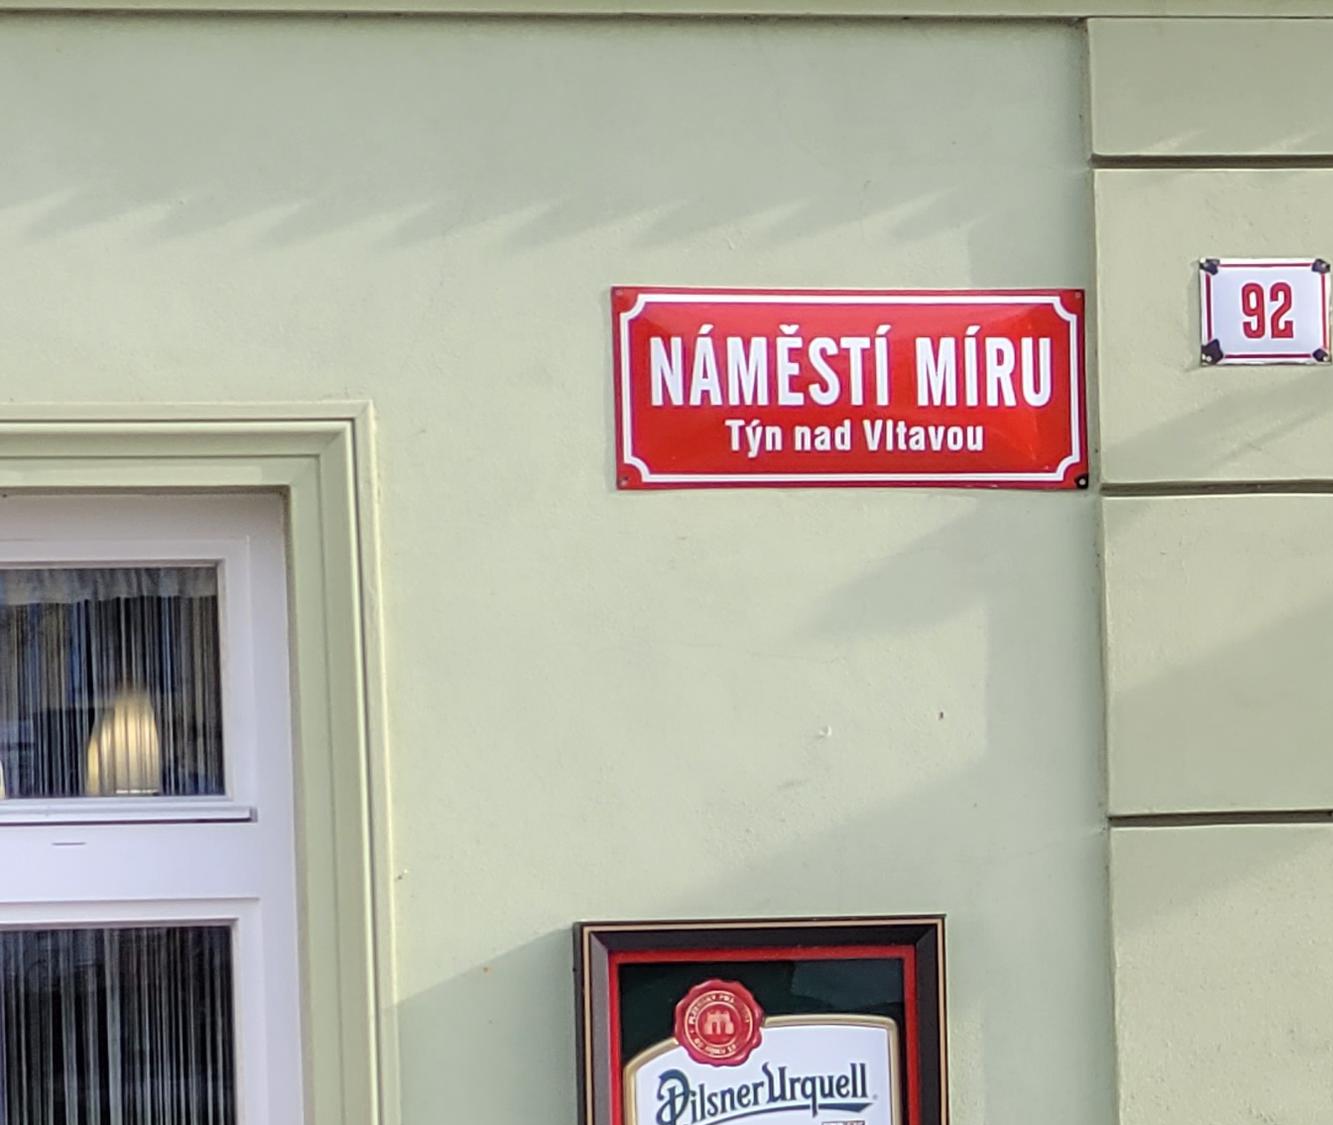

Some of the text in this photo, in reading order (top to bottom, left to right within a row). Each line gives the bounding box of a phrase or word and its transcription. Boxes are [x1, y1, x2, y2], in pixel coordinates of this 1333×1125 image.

[1241, 281, 1294, 339] 92
[649, 324, 1053, 408] NÁMĚSTÍ MÍRU
[724, 419, 984, 459] Týn nad Vltavou
[762, 1061, 868, 1118] Urquell
